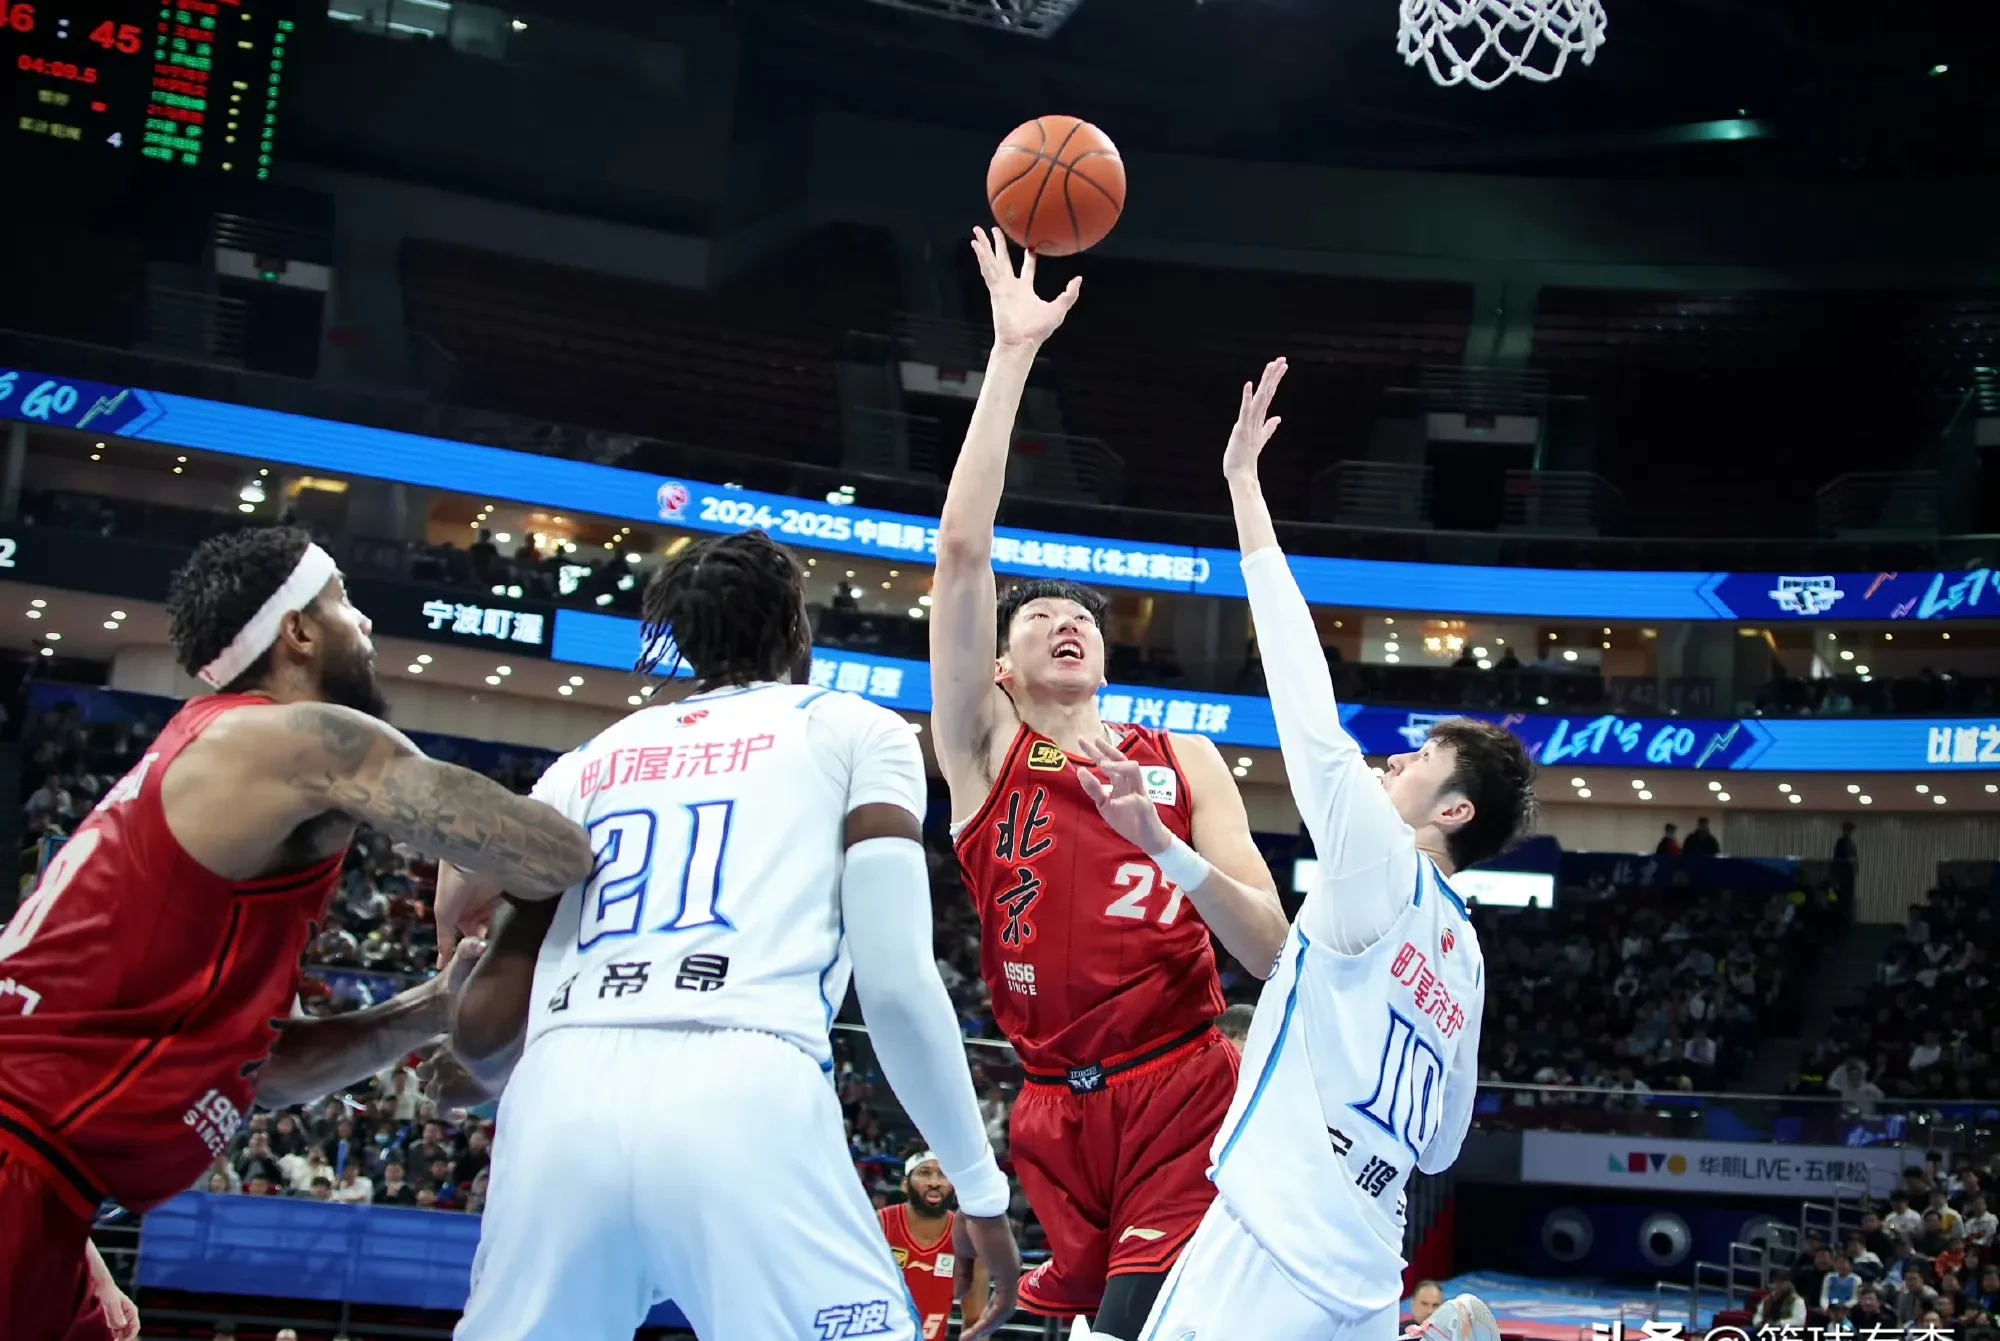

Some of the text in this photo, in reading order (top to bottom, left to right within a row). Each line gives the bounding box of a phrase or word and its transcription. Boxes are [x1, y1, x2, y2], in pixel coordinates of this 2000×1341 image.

[0, 0, 36, 32] 6
[89, 20, 142, 54] 45
[106, 132, 123, 148] 4
[20, 380, 79, 420] GO
[700, 496, 851, 541] 2024-2025
[422, 599, 544, 644] 宁波町渥
[1541, 713, 1696, 765] LET'S GO
[580, 733, 776, 799] 町渥洗护
[577, 799, 738, 954] 21
[996, 788, 1052, 946] 北京
[1003, 961, 1036, 983] 1956
[1008, 980, 1037, 996] SINCE
[1348, 1002, 1445, 1163] 10
[814, 1299, 894, 1341] 宁波
